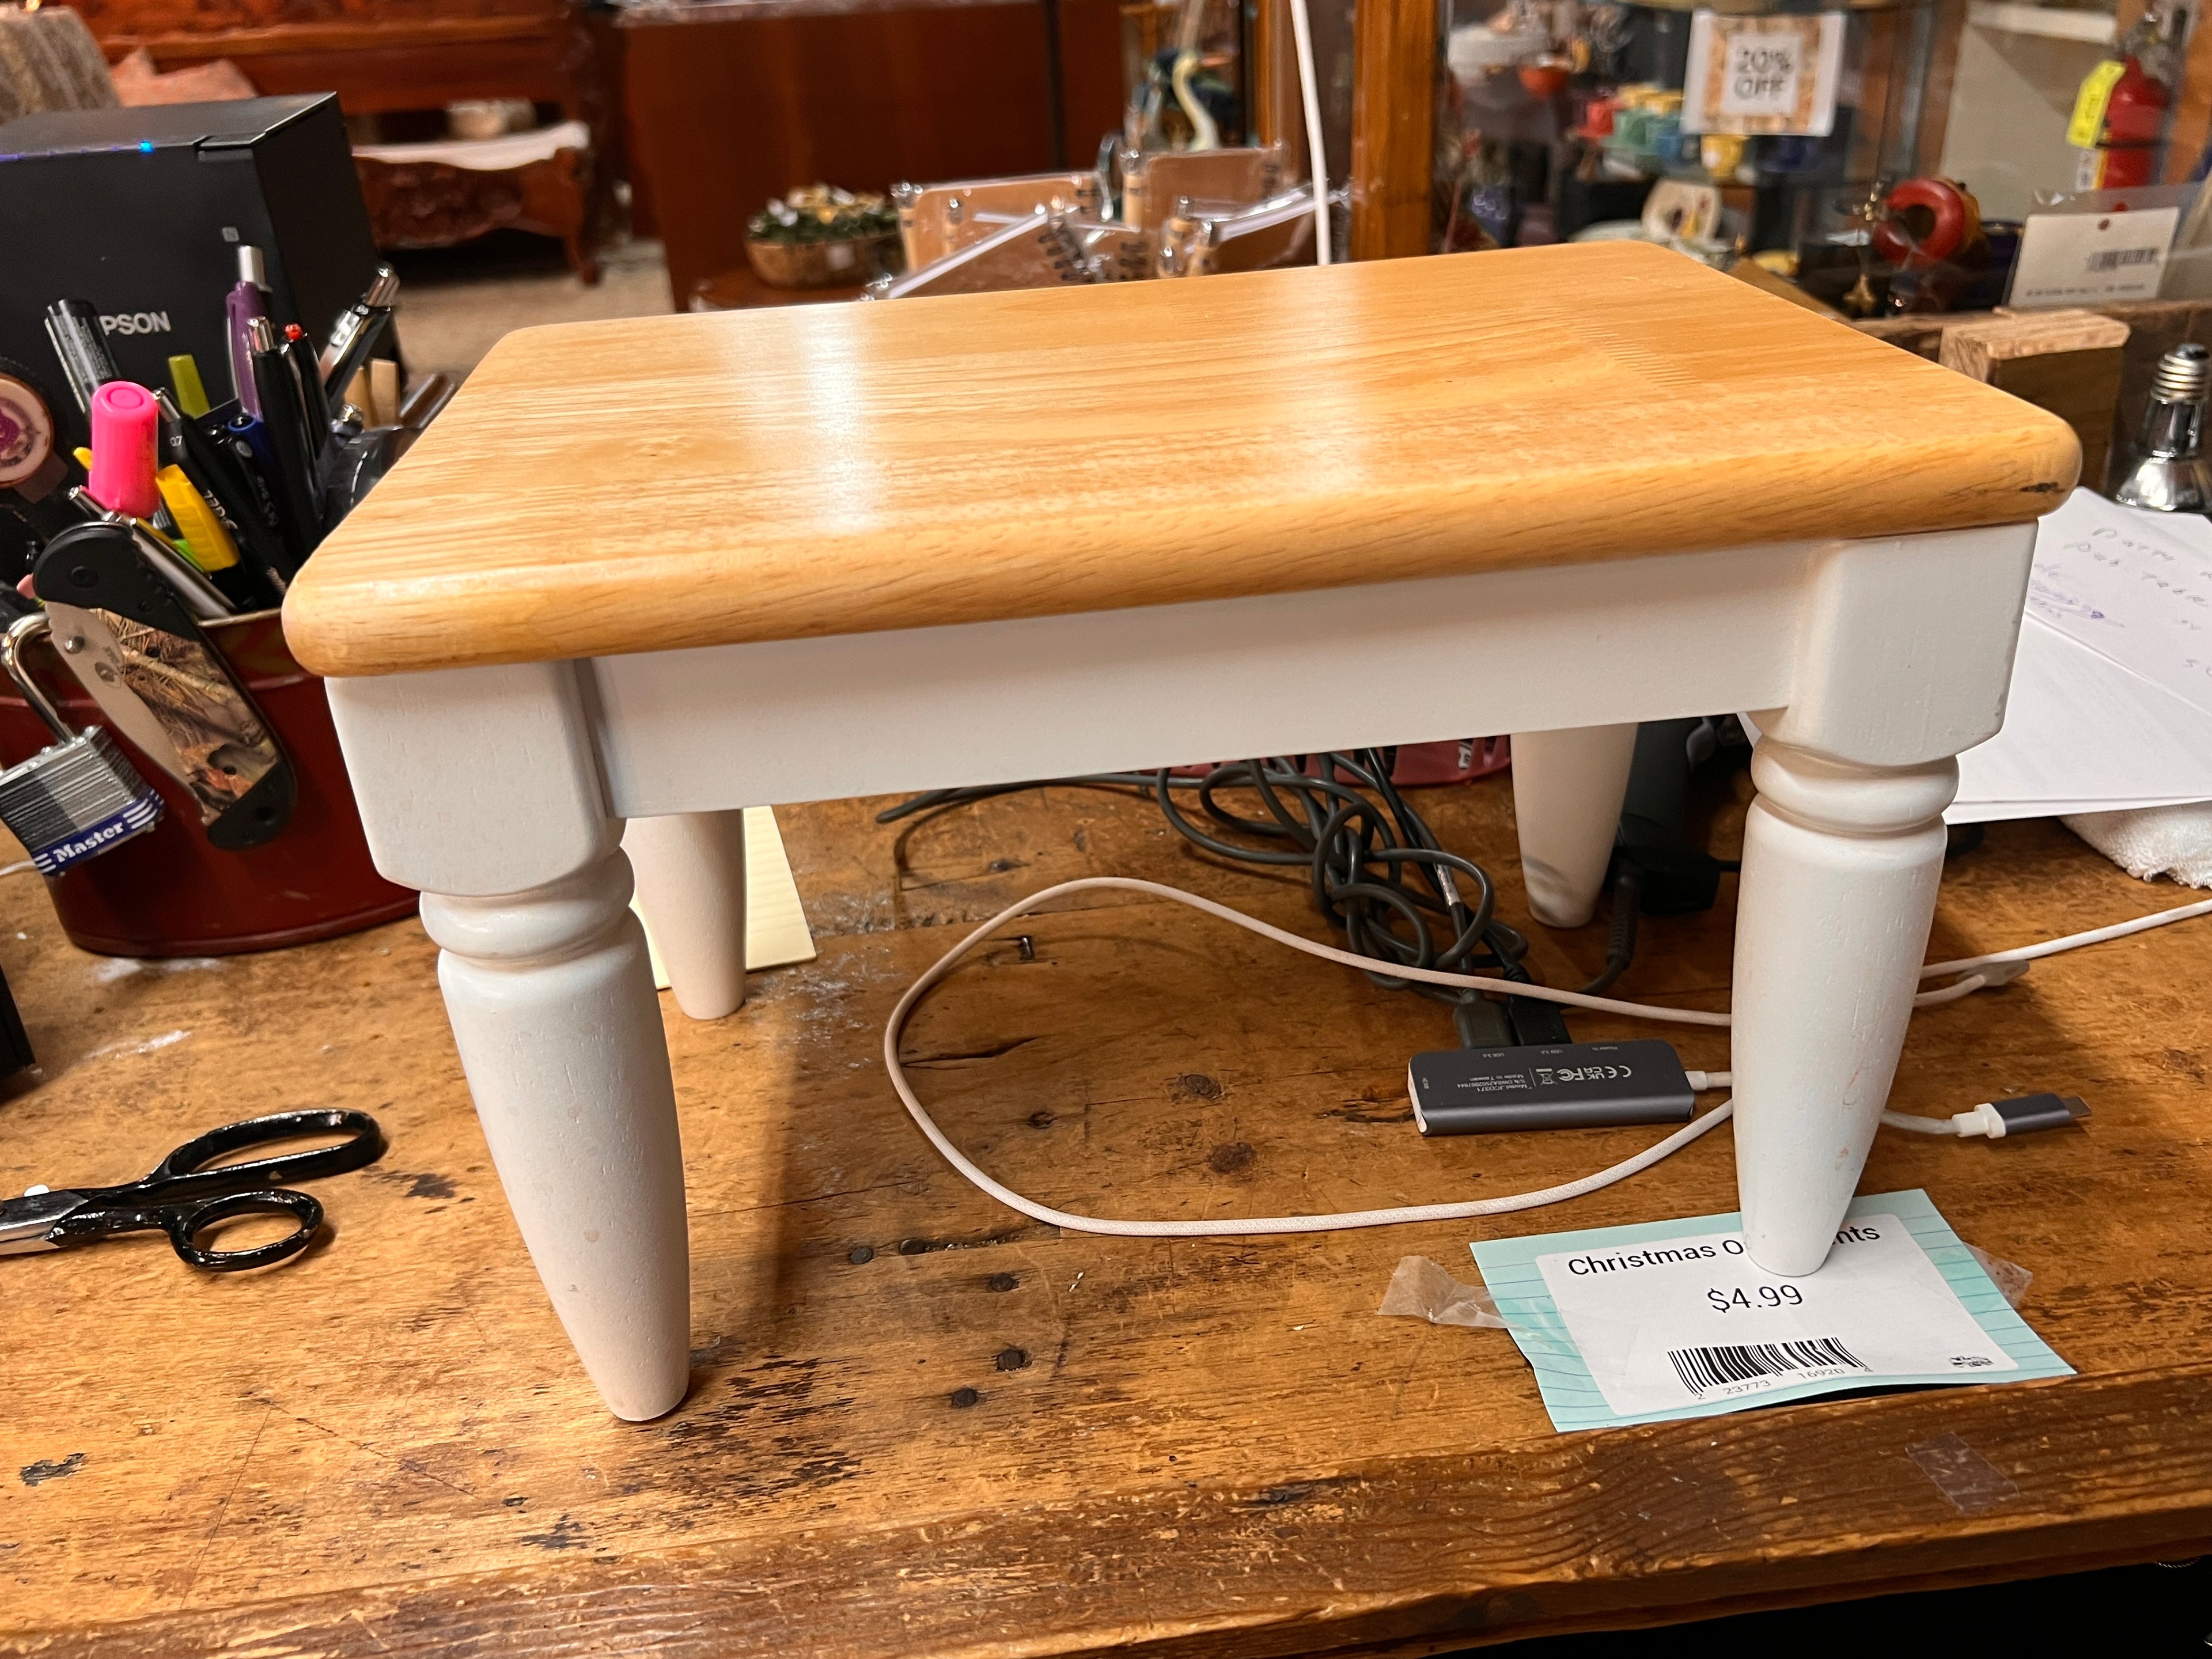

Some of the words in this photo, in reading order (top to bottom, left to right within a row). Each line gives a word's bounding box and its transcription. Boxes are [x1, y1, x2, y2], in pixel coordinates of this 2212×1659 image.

[99, 311, 171, 336] PSON
[53, 822, 124, 863] Master
[1568, 1243, 1717, 1275] Christmas
[1707, 1285, 1803, 1313] $4.99
[1723, 1380, 1771, 1395] 23773
[1797, 1368, 1845, 1379] 16920
